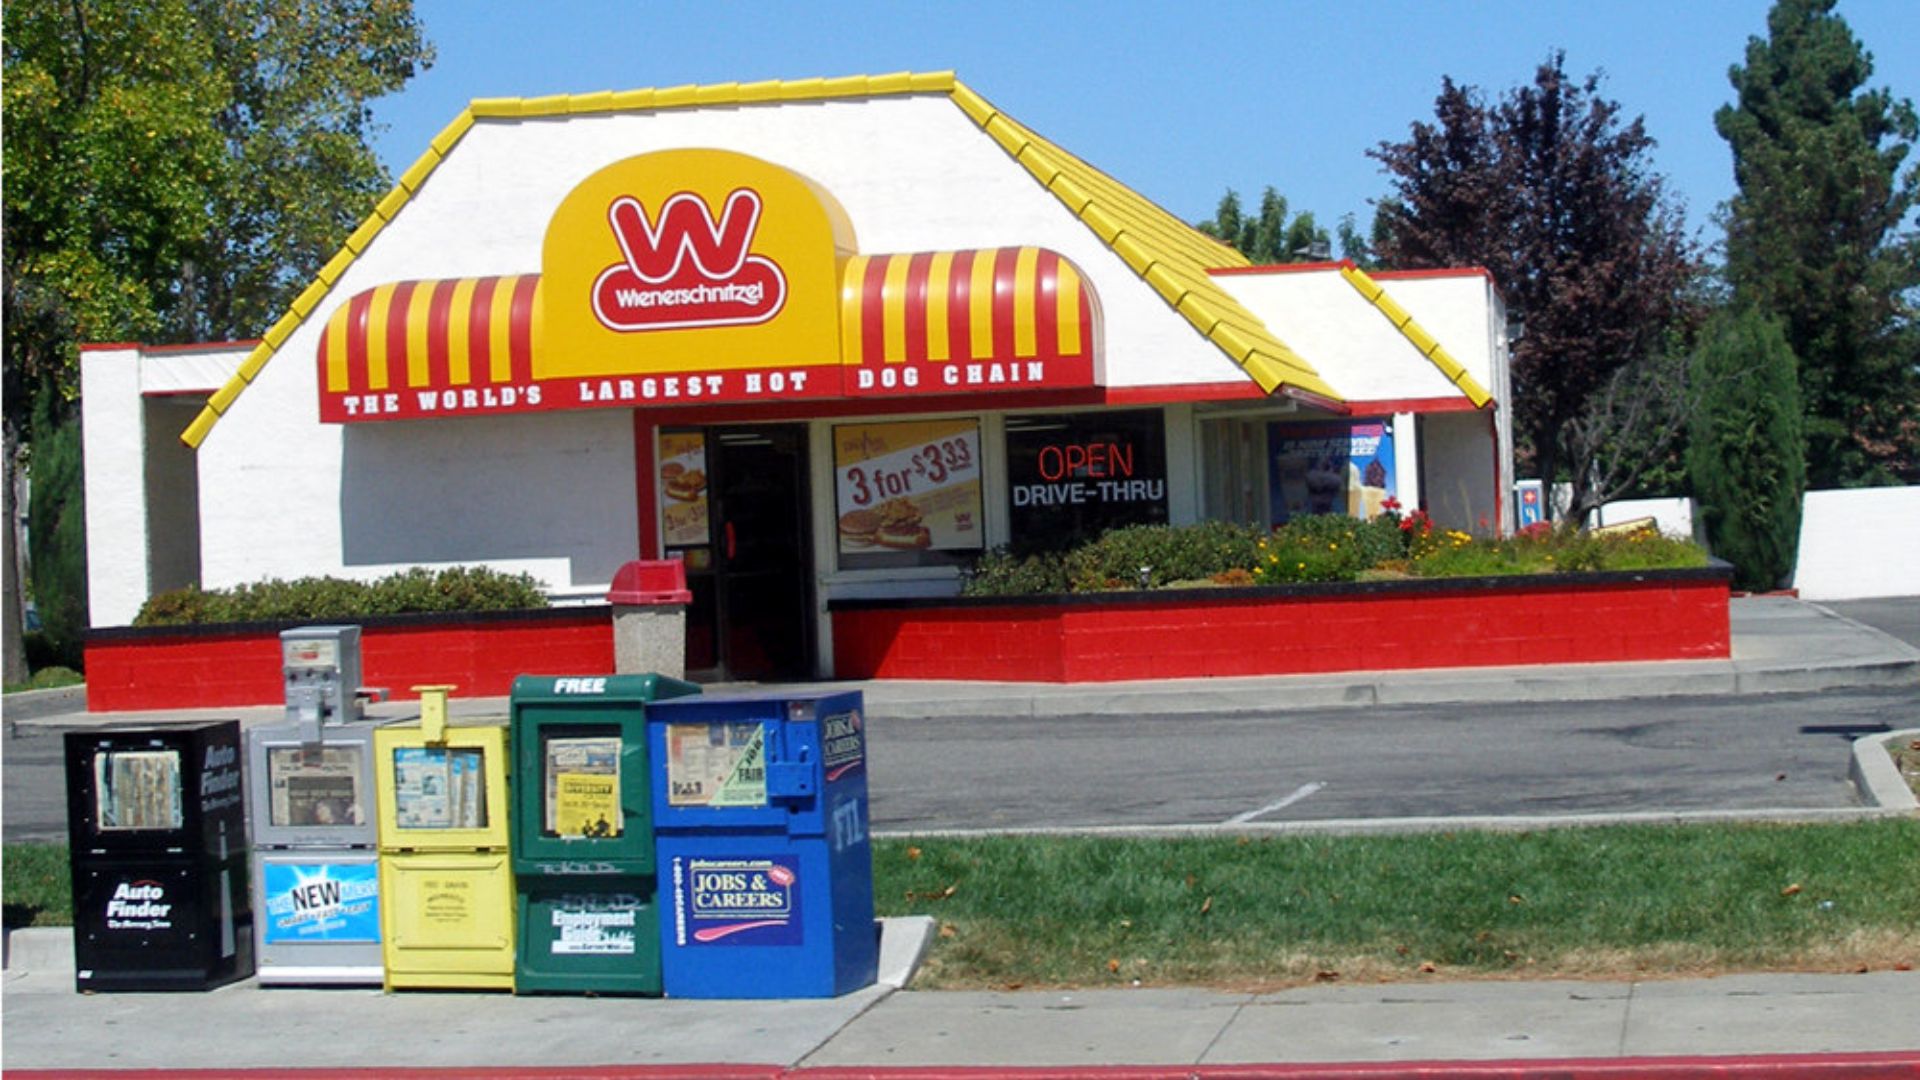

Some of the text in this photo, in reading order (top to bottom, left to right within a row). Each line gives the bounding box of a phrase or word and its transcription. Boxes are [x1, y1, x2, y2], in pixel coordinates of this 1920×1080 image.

[608, 187, 762, 283] W
[615, 281, 764, 309] Wienerschnitzel
[343, 361, 1044, 415] THE WORLD'S LARGEST HOT DOG CHAIN
[1038, 442, 1134, 481] OPEN
[848, 467, 872, 506] 3
[873, 467, 912, 497] for
[1013, 479, 1165, 507] DRIVE-THRU
[554, 677, 608, 693] FREE
[113, 883, 164, 900] Auto
[292, 880, 341, 912] NEW
[695, 873, 768, 893] JOBS &
[107, 900, 171, 918] Finder
[696, 892, 784, 908] CAREERS
[551, 909, 635, 930] Employment
